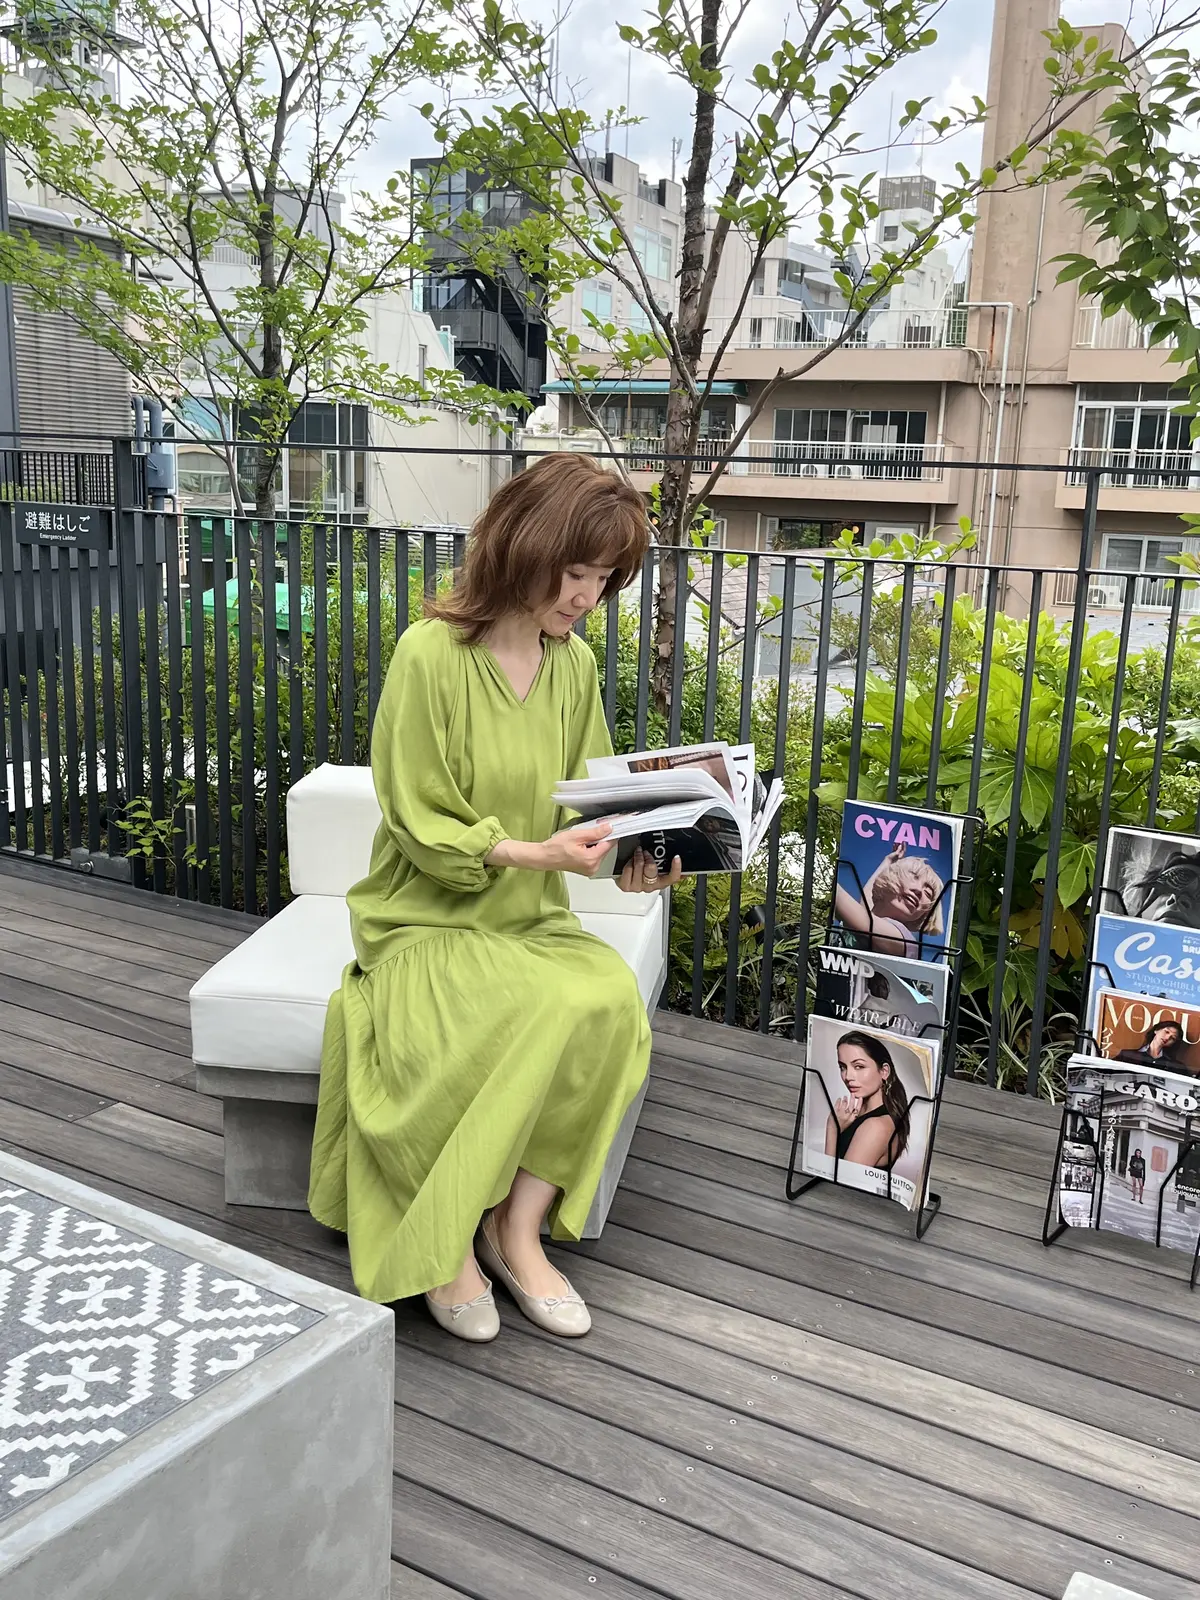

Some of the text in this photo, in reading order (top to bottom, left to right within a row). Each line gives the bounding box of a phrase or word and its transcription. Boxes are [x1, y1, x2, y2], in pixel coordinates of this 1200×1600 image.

[25, 511, 91, 532] 避難はしご
[39, 532, 62, 541] Emergency
[854, 813, 940, 851] CYAN
[1125, 971, 1195, 992] STUDIO GHIBLI
[835, 1004, 921, 1033] WEARABLE
[1084, 1076, 1198, 1111] FIGARO
[864, 1169, 887, 1181] LOUIS
